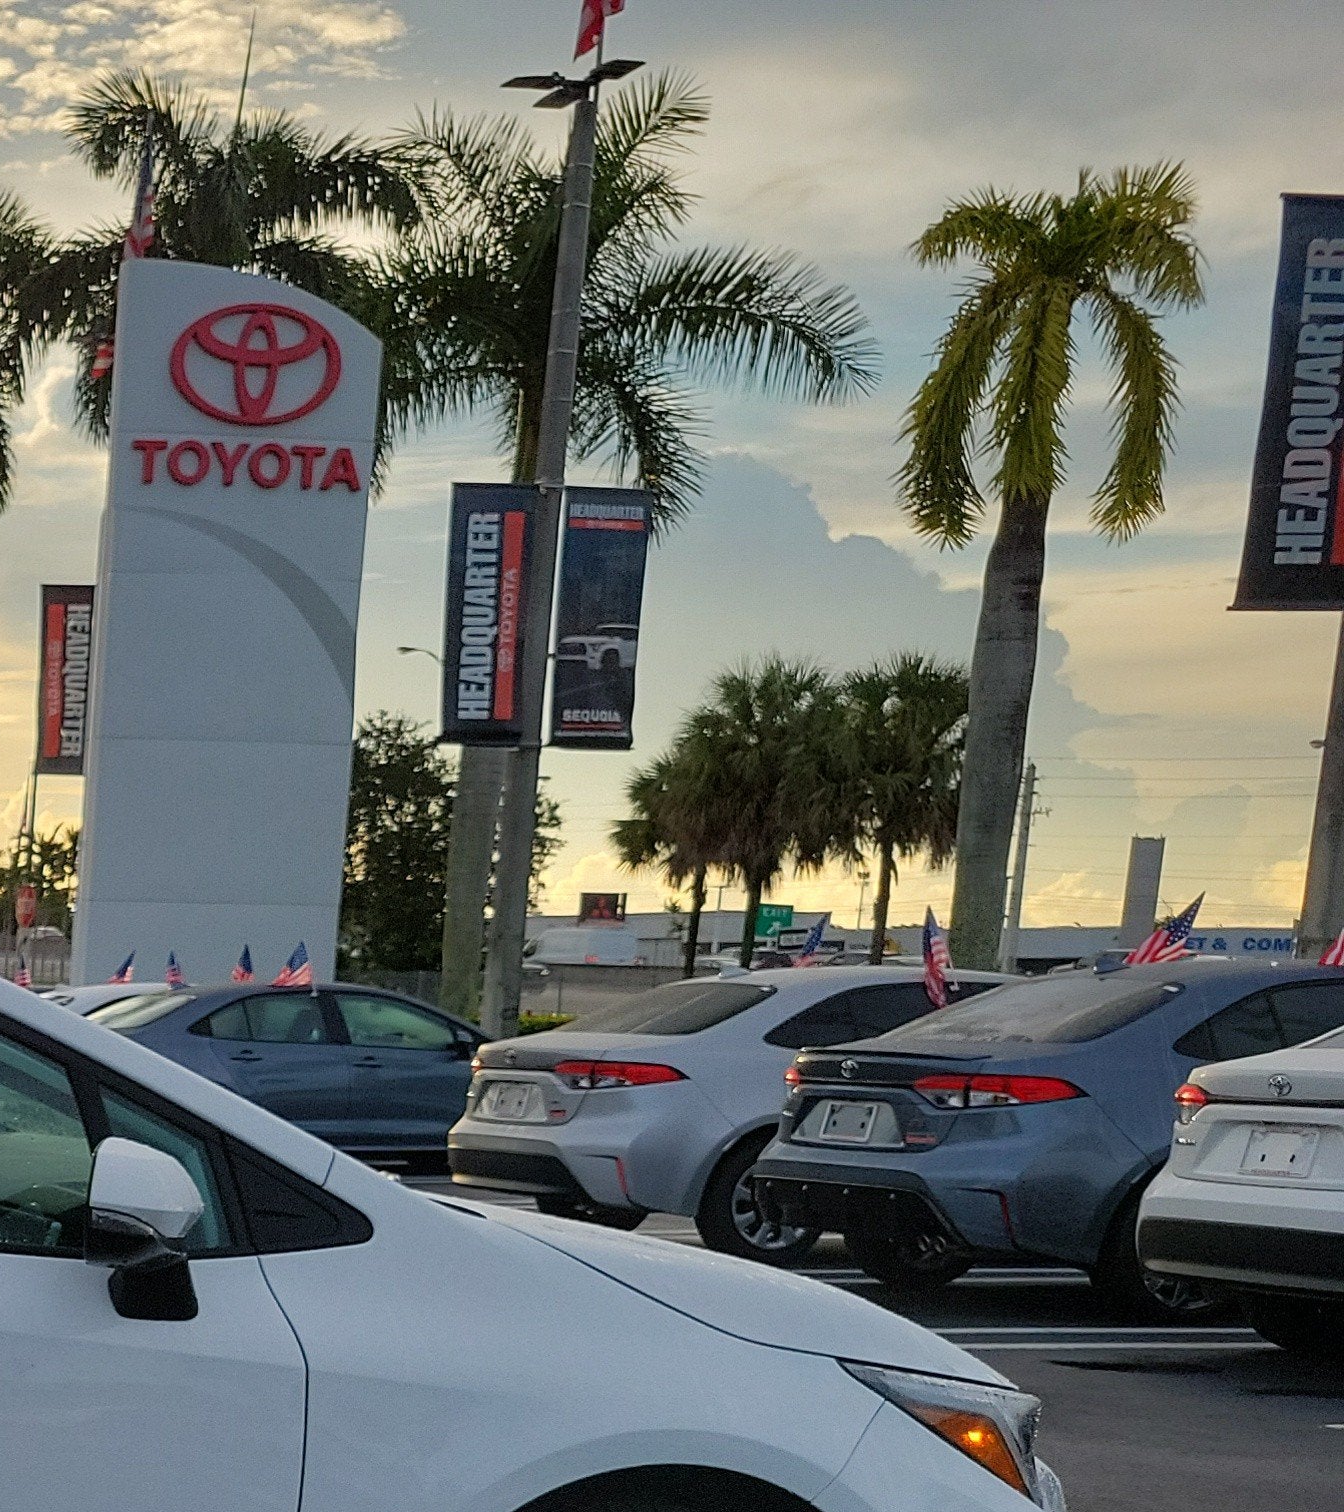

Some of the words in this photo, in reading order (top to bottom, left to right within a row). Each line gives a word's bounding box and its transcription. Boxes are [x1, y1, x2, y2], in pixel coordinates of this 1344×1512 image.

[1274, 236, 1344, 566] HEADQUARTER
[132, 439, 362, 492] TOYOTA
[457, 511, 501, 721] HEADQUARTER
[499, 568, 522, 645] TOYOTA
[60, 602, 92, 758] HEADQUARTER
[562, 708, 621, 723] SEQUOIA
[762, 907, 788, 918] EXIT
